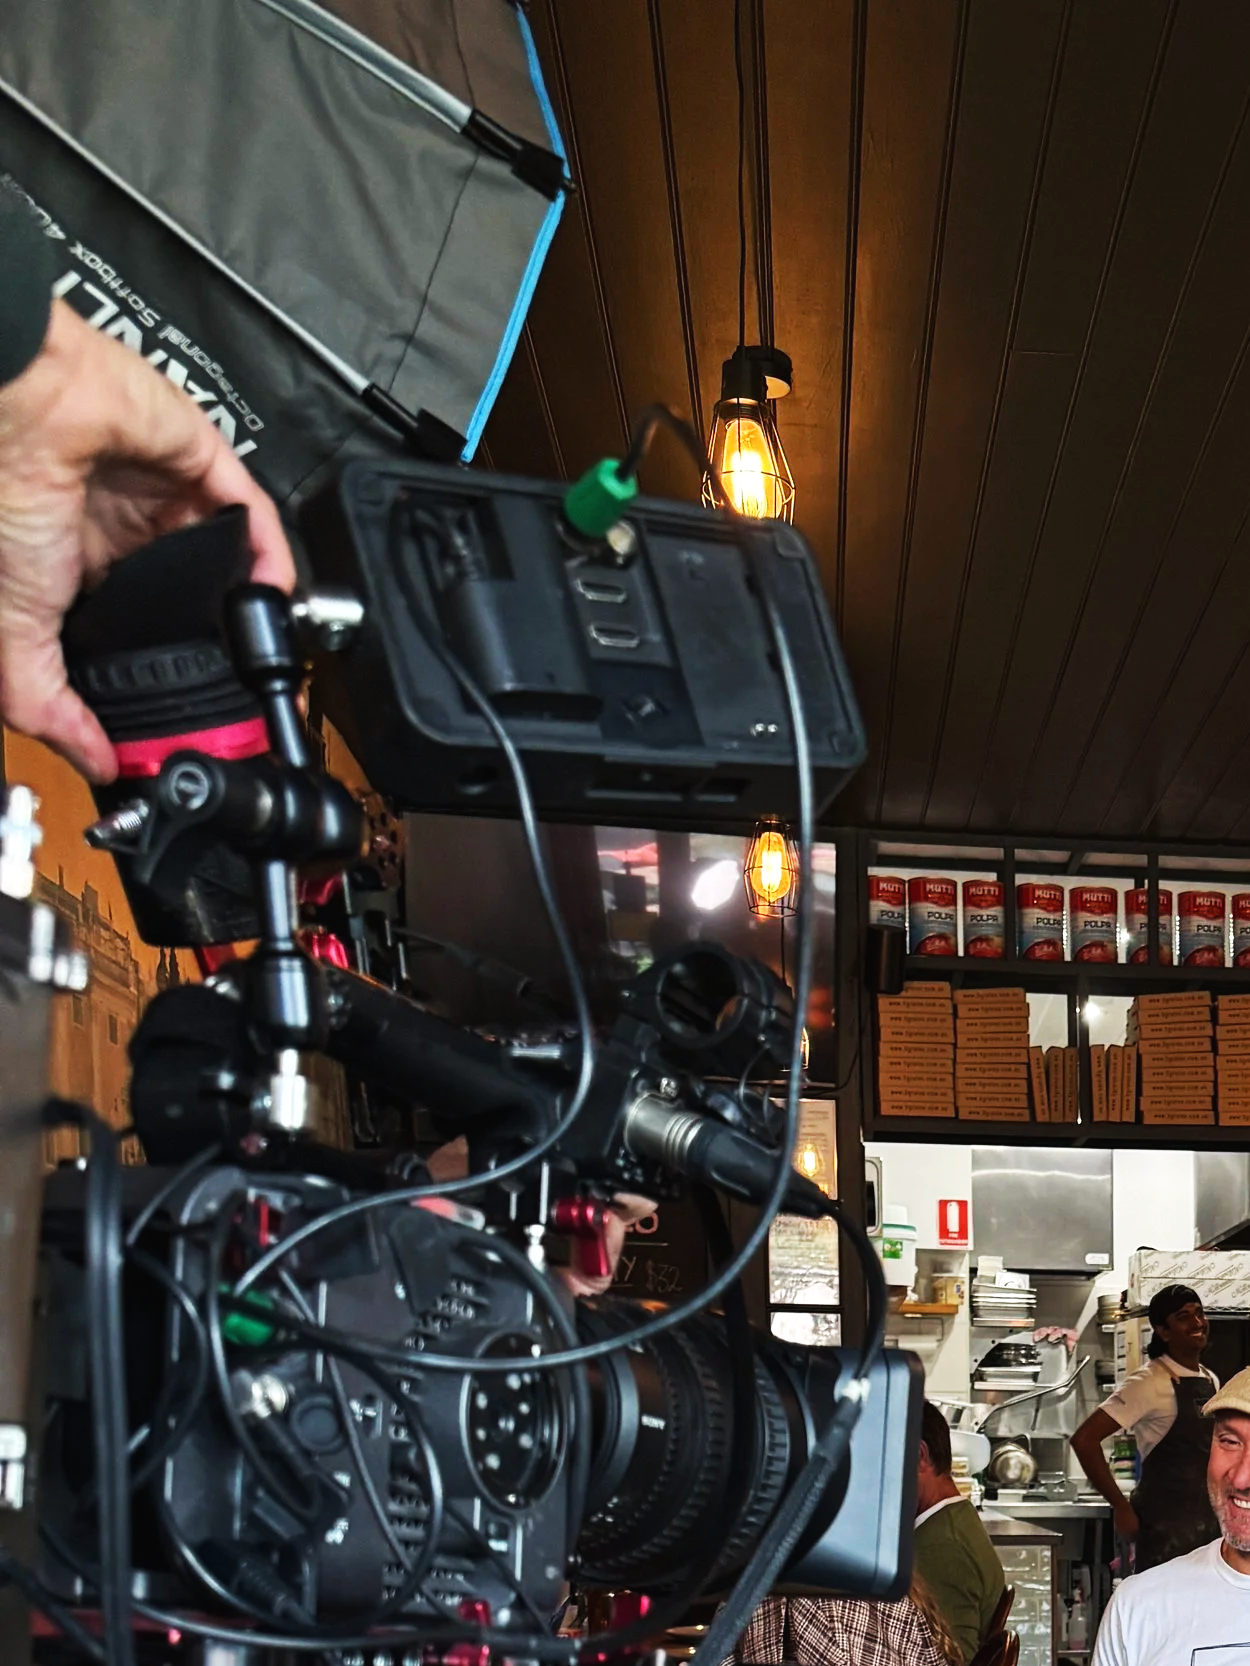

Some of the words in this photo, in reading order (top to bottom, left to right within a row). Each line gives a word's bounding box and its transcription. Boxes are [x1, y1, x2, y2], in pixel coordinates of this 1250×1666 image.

[68, 241, 160, 328] Softbox
[158, 325, 264, 431] Octagonal
[969, 887, 998, 895] MUTTI
[1083, 893, 1111, 902] MUTTI
